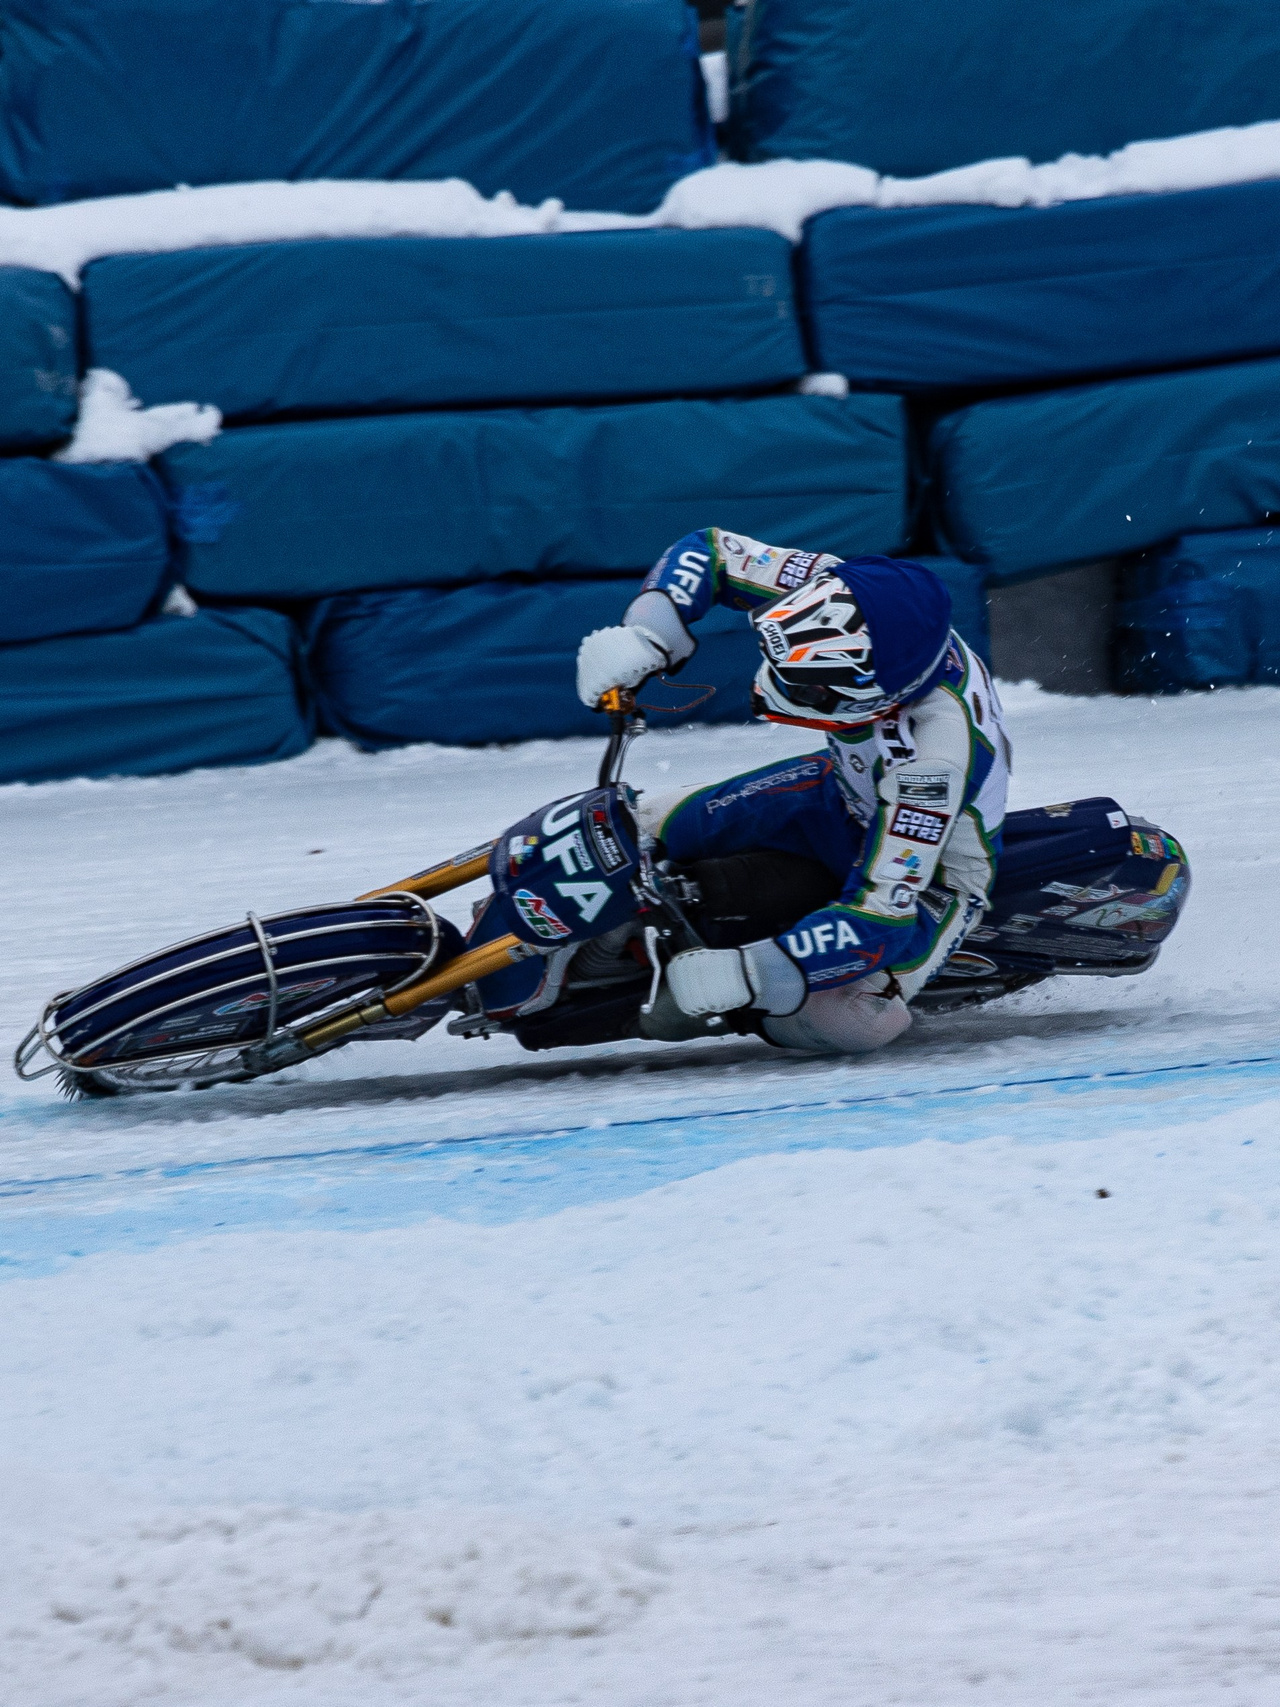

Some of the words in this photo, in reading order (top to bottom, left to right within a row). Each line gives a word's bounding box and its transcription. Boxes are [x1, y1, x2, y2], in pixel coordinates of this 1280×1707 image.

[667, 551, 710, 606] UFA
[762, 623, 786, 656] SHOEI
[892, 822, 942, 843] MTRS
[895, 808, 945, 828] COOL
[541, 793, 613, 923] UFA
[786, 920, 861, 959] UFA
